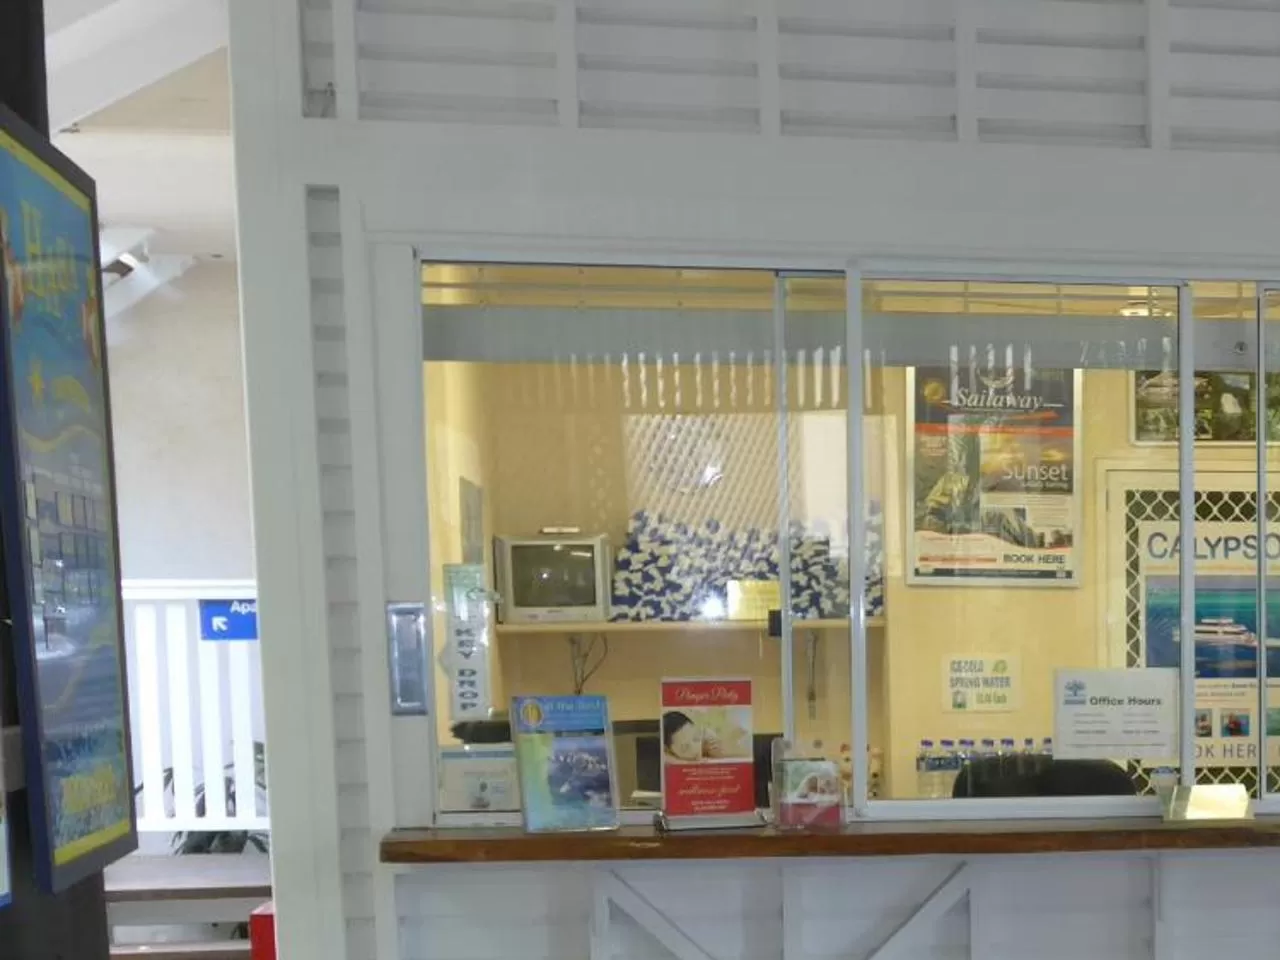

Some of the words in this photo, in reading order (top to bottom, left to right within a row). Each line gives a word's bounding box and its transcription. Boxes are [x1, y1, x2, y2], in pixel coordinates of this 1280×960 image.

[956, 387, 1044, 411] Sailaway
[1002, 462, 1069, 481] Sunset
[1003, 553, 1035, 563] BOOK
[1038, 554, 1066, 565] HERE
[1089, 695, 1125, 706] Office
[1128, 695, 1162, 706] Hours
